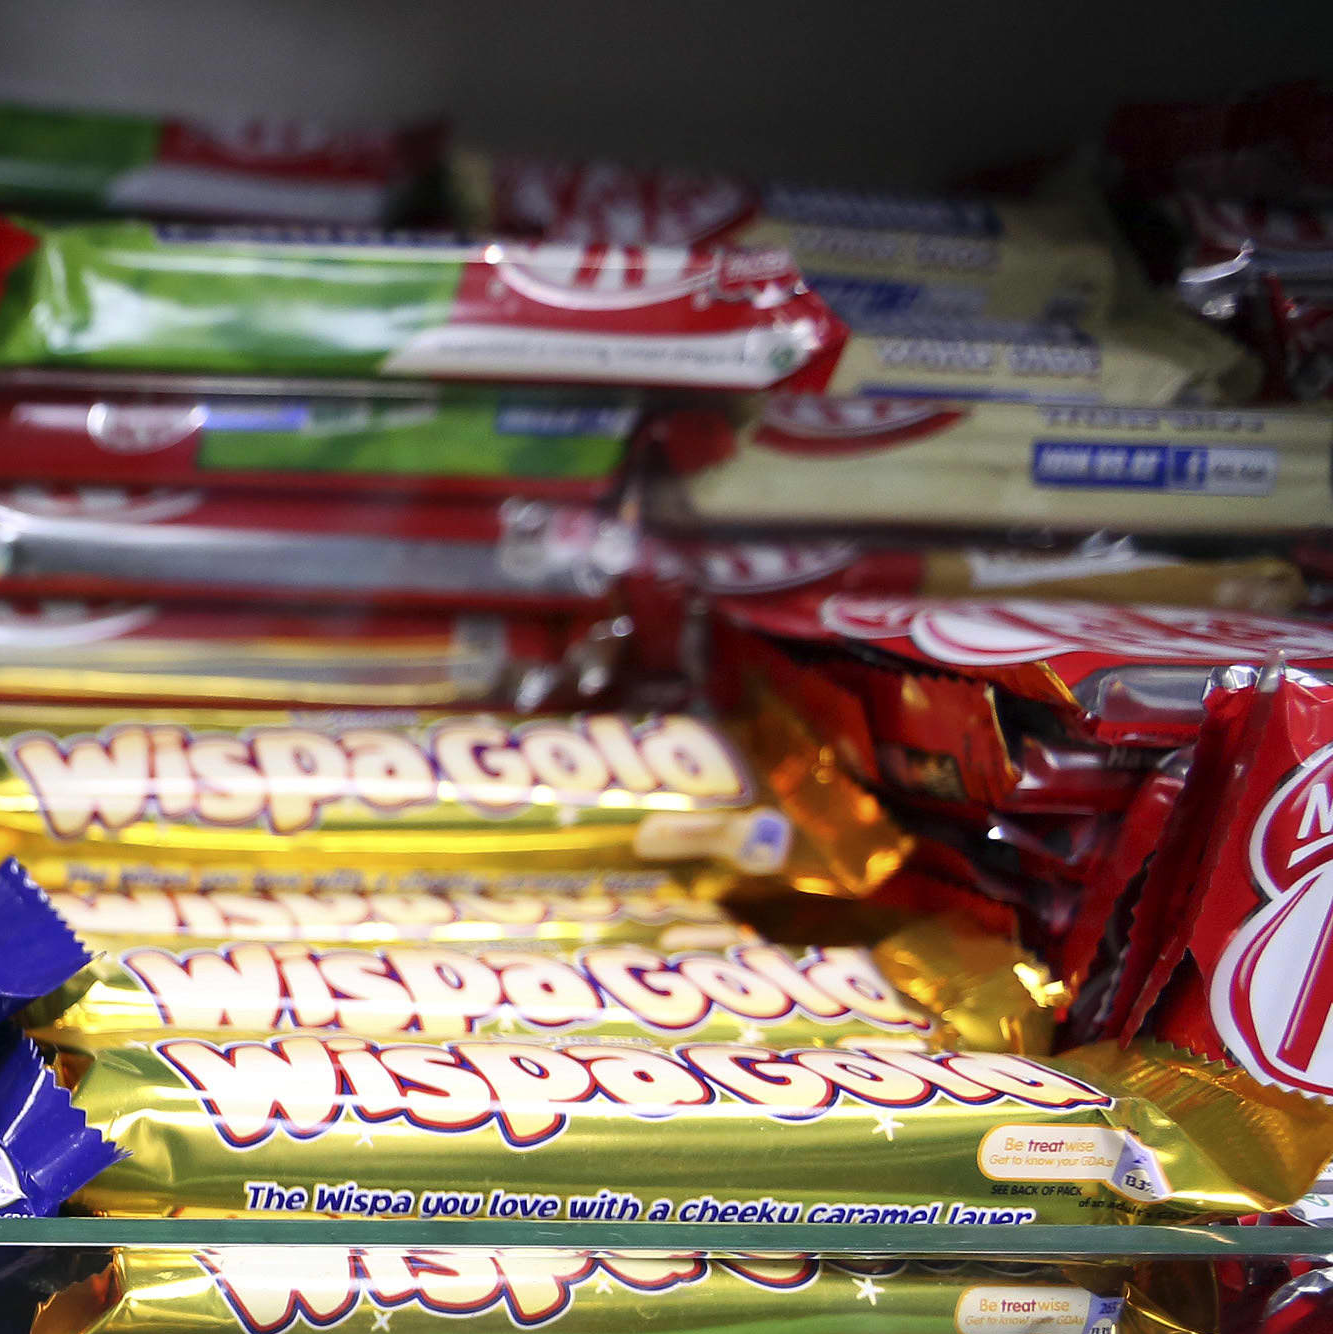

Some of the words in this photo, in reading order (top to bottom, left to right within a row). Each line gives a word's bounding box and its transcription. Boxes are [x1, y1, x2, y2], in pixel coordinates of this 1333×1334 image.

[990, 1185, 1009, 1196] SEE
[1010, 1184, 1039, 1196] BACK
[1041, 1185, 1056, 1196] OF
[1056, 1185, 1083, 1196] PACK
[247, 1183, 307, 1212] The
[315, 1183, 416, 1217] Wispa
[422, 1194, 480, 1218] you
[488, 1190, 559, 1219] love
[568, 1190, 640, 1221] with
[648, 1201, 673, 1222] a
[678, 1196, 802, 1223] cheeky
[807, 1201, 939, 1225] caramel
[947, 1203, 1036, 1225] layer
